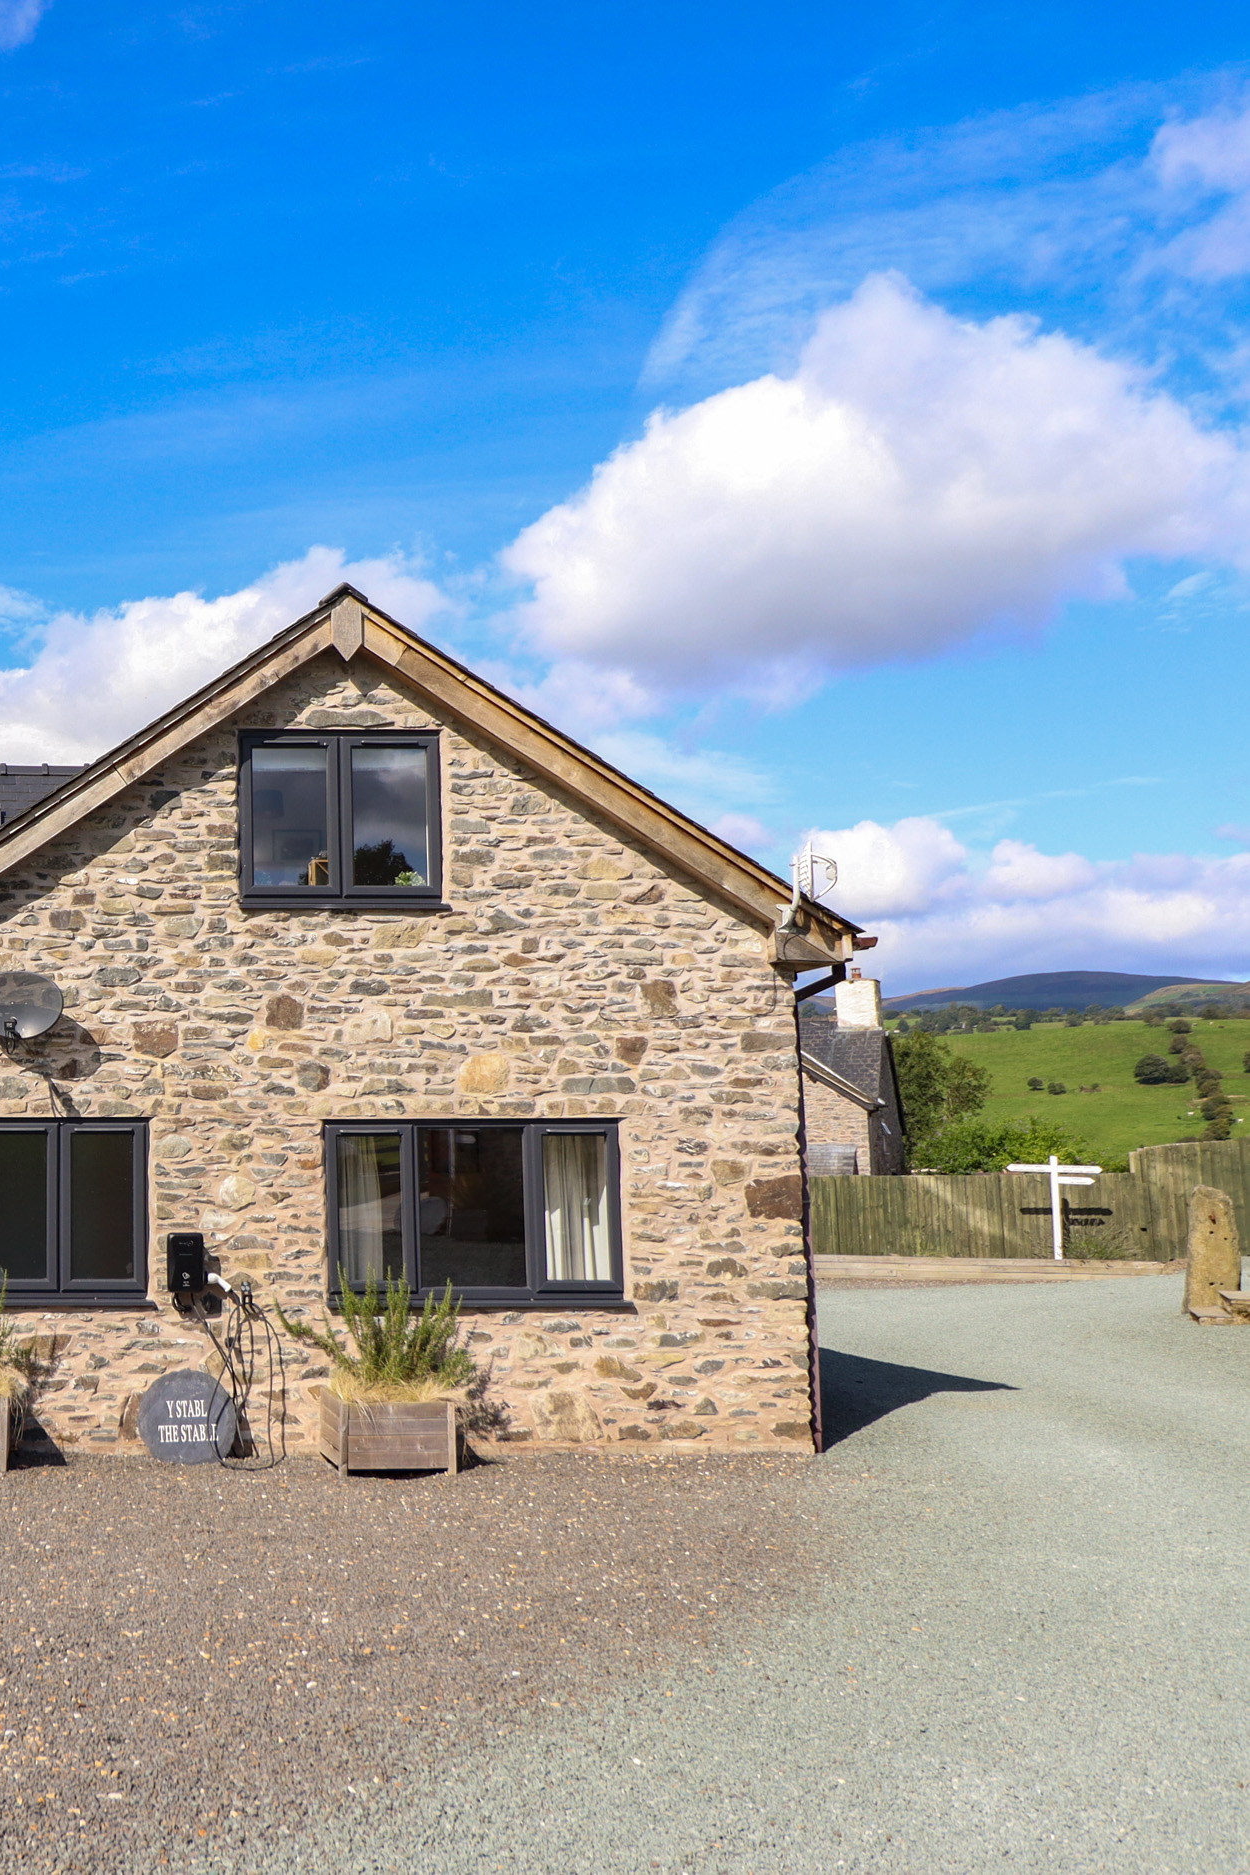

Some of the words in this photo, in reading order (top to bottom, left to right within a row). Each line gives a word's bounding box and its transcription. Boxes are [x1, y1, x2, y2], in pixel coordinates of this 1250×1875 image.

[166, 1400, 174, 1418] Y
[176, 1400, 207, 1418] STABL
[158, 1424, 179, 1443] THE
